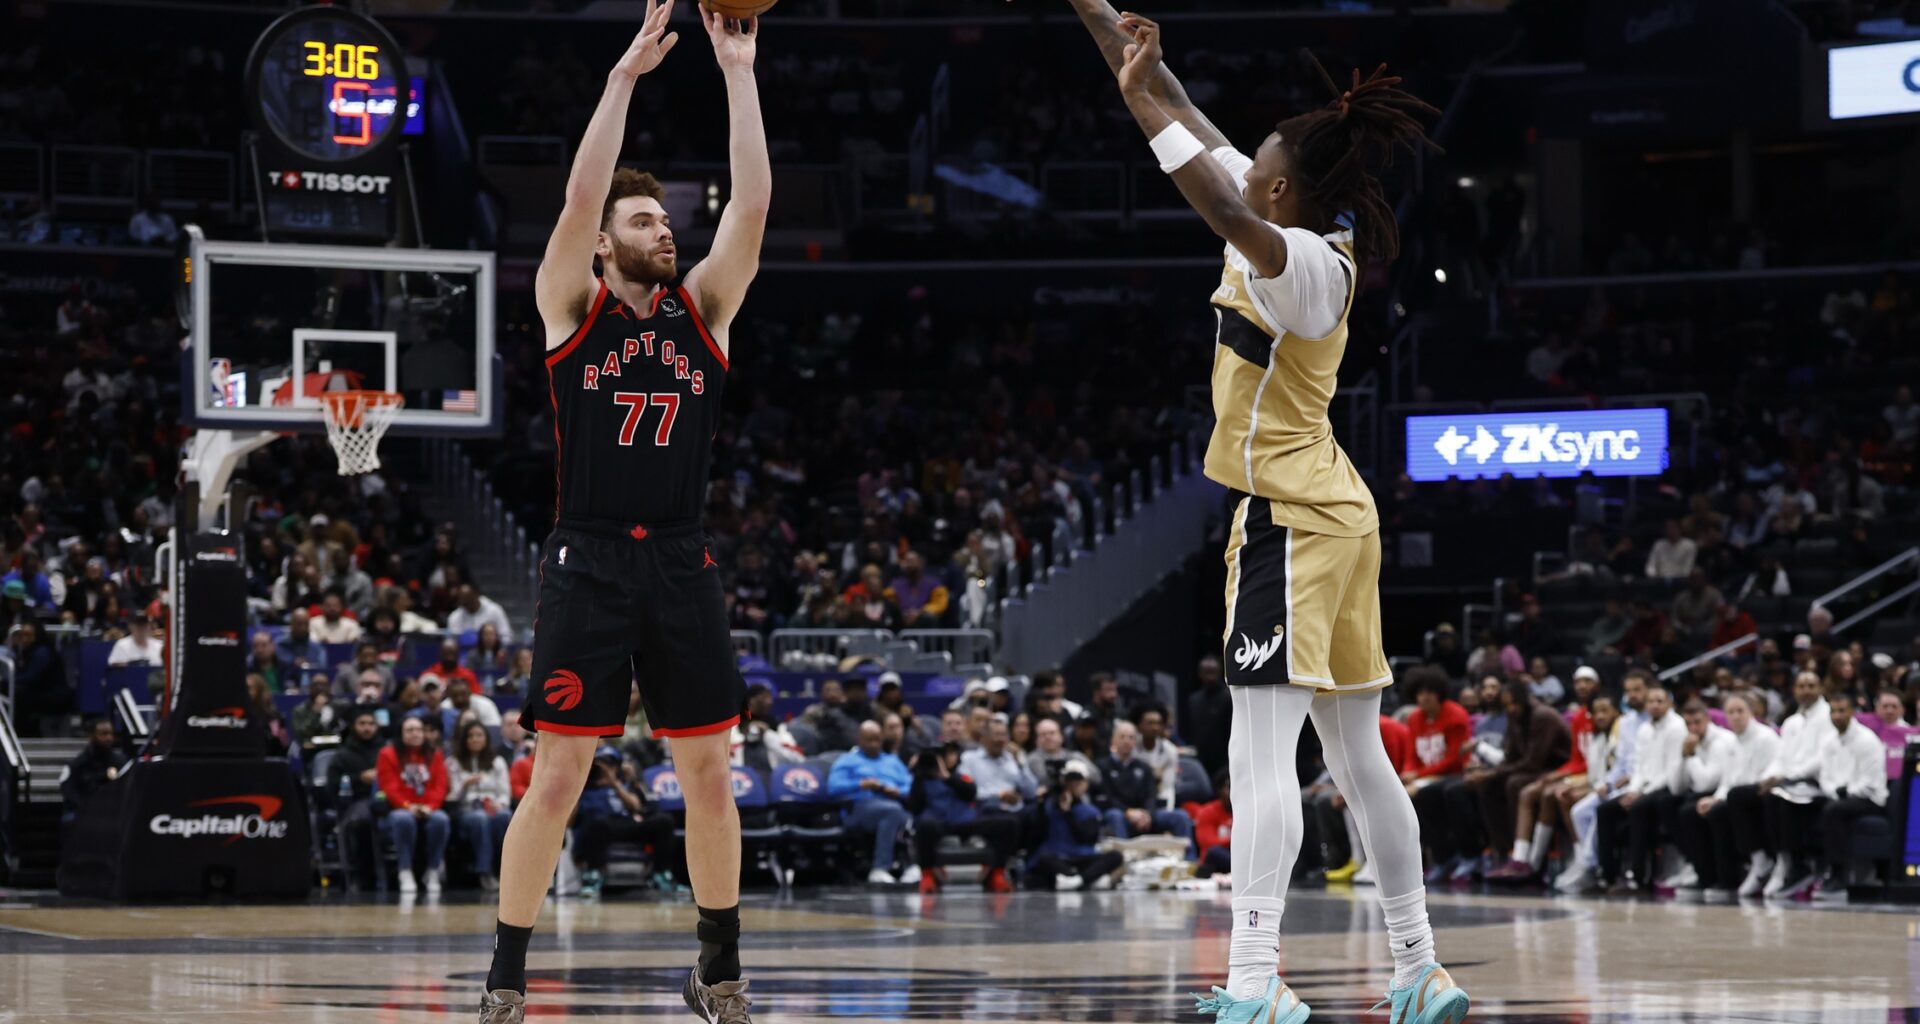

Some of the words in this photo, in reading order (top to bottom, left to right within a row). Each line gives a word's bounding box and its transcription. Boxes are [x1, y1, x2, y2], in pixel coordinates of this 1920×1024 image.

[303, 41, 379, 80] 3:06
[333, 81, 371, 146] 5
[301, 171, 392, 194] TISSOT
[583, 331, 704, 394] RAPTORS
[614, 392, 680, 446] 77
[1501, 423, 1641, 470] ZKsync
